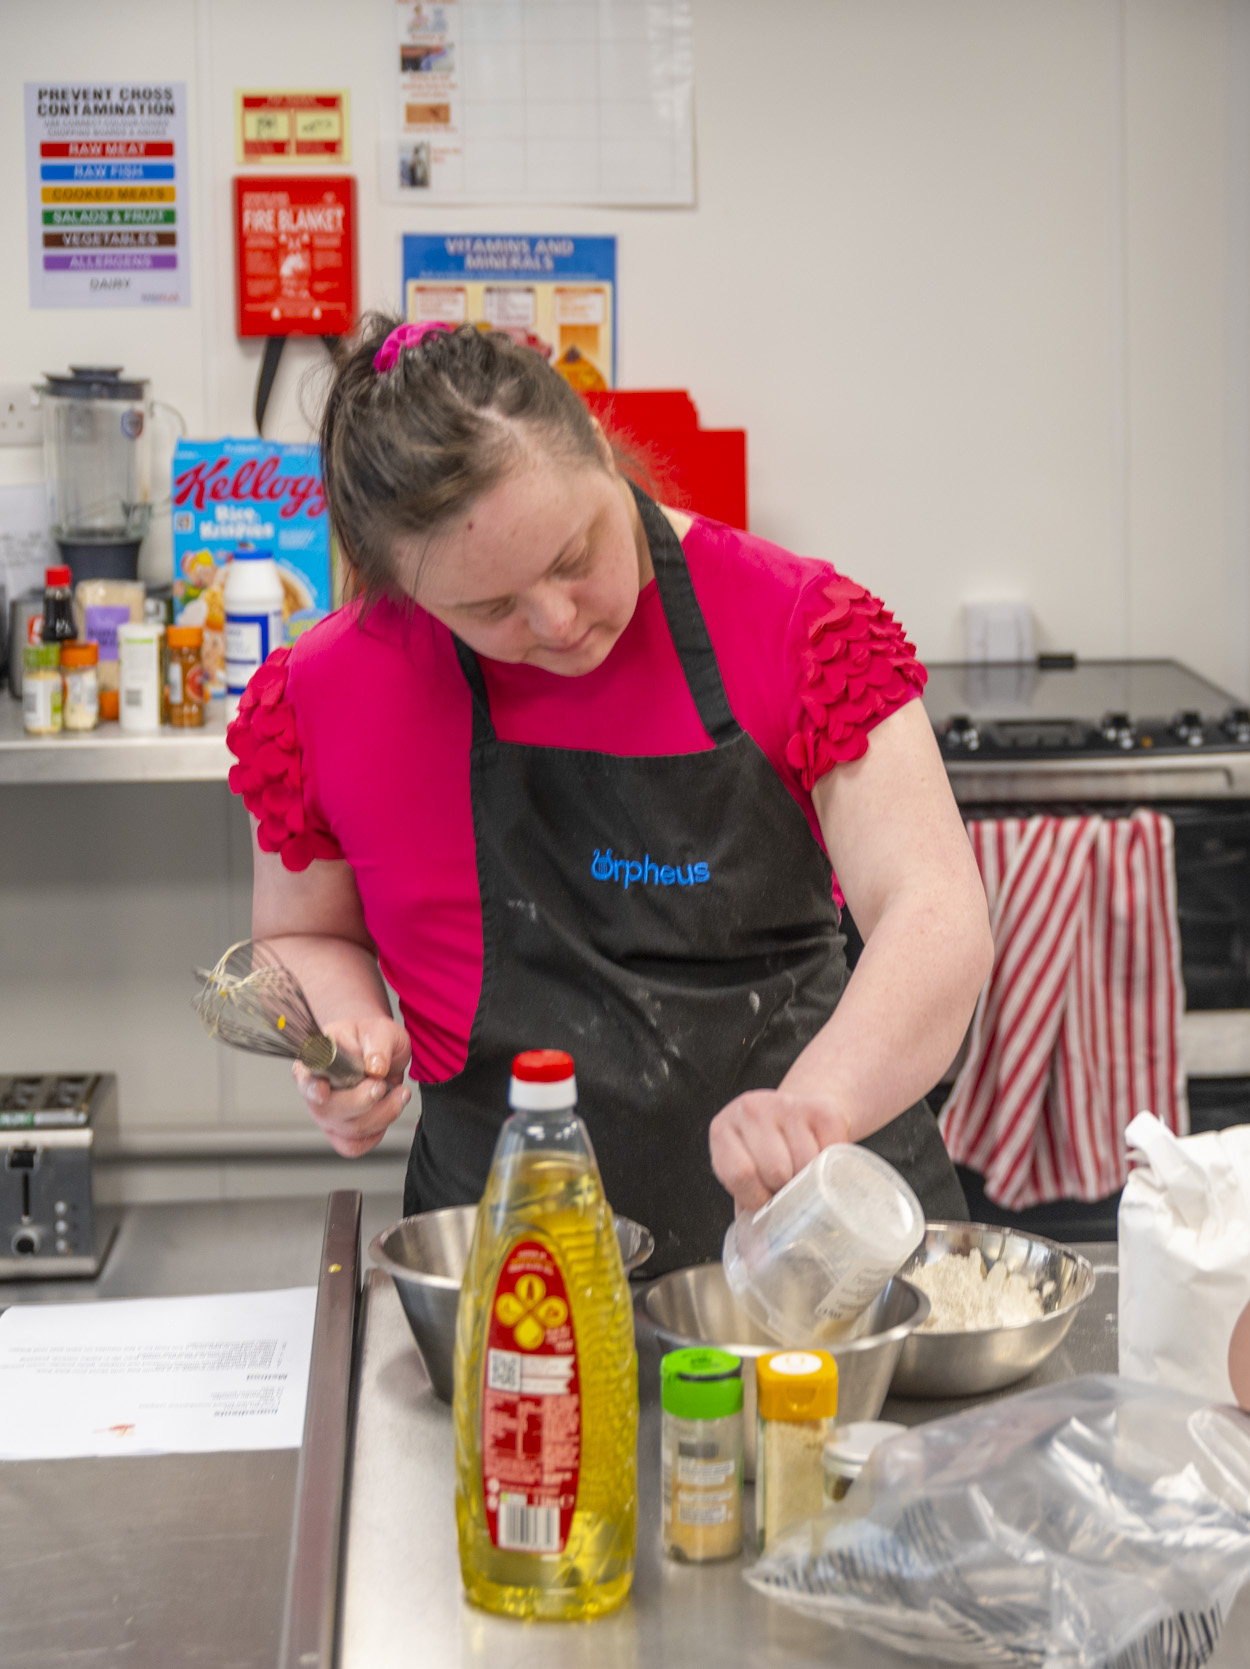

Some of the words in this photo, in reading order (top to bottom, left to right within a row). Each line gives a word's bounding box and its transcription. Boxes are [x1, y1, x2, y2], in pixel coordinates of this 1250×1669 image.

[38, 87, 112, 101] PREVENT
[119, 87, 173, 101] CROSS
[37, 102, 176, 117] CONTAMINATION
[68, 141, 102, 155] RAW
[105, 141, 147, 155] MEAT
[74, 163, 106, 178] RAW
[110, 163, 145, 177] FISH
[52, 187, 114, 200] COOKED
[118, 187, 165, 199] MEATS
[53, 209, 109, 223] SALADS
[112, 210, 123, 222] &
[124, 209, 165, 222] FRUIT
[243, 208, 275, 232] FIRE
[278, 207, 345, 232] BLANKET
[62, 233, 158, 246] VEGETABLES
[444, 237, 530, 256] VITAMINS
[534, 238, 575, 257] AND
[69, 255, 152, 268] ALLERGENS
[464, 255, 555, 271] MINERALS
[89, 278, 132, 291] DAIRY
[591, 848, 711, 890] Orpheus
